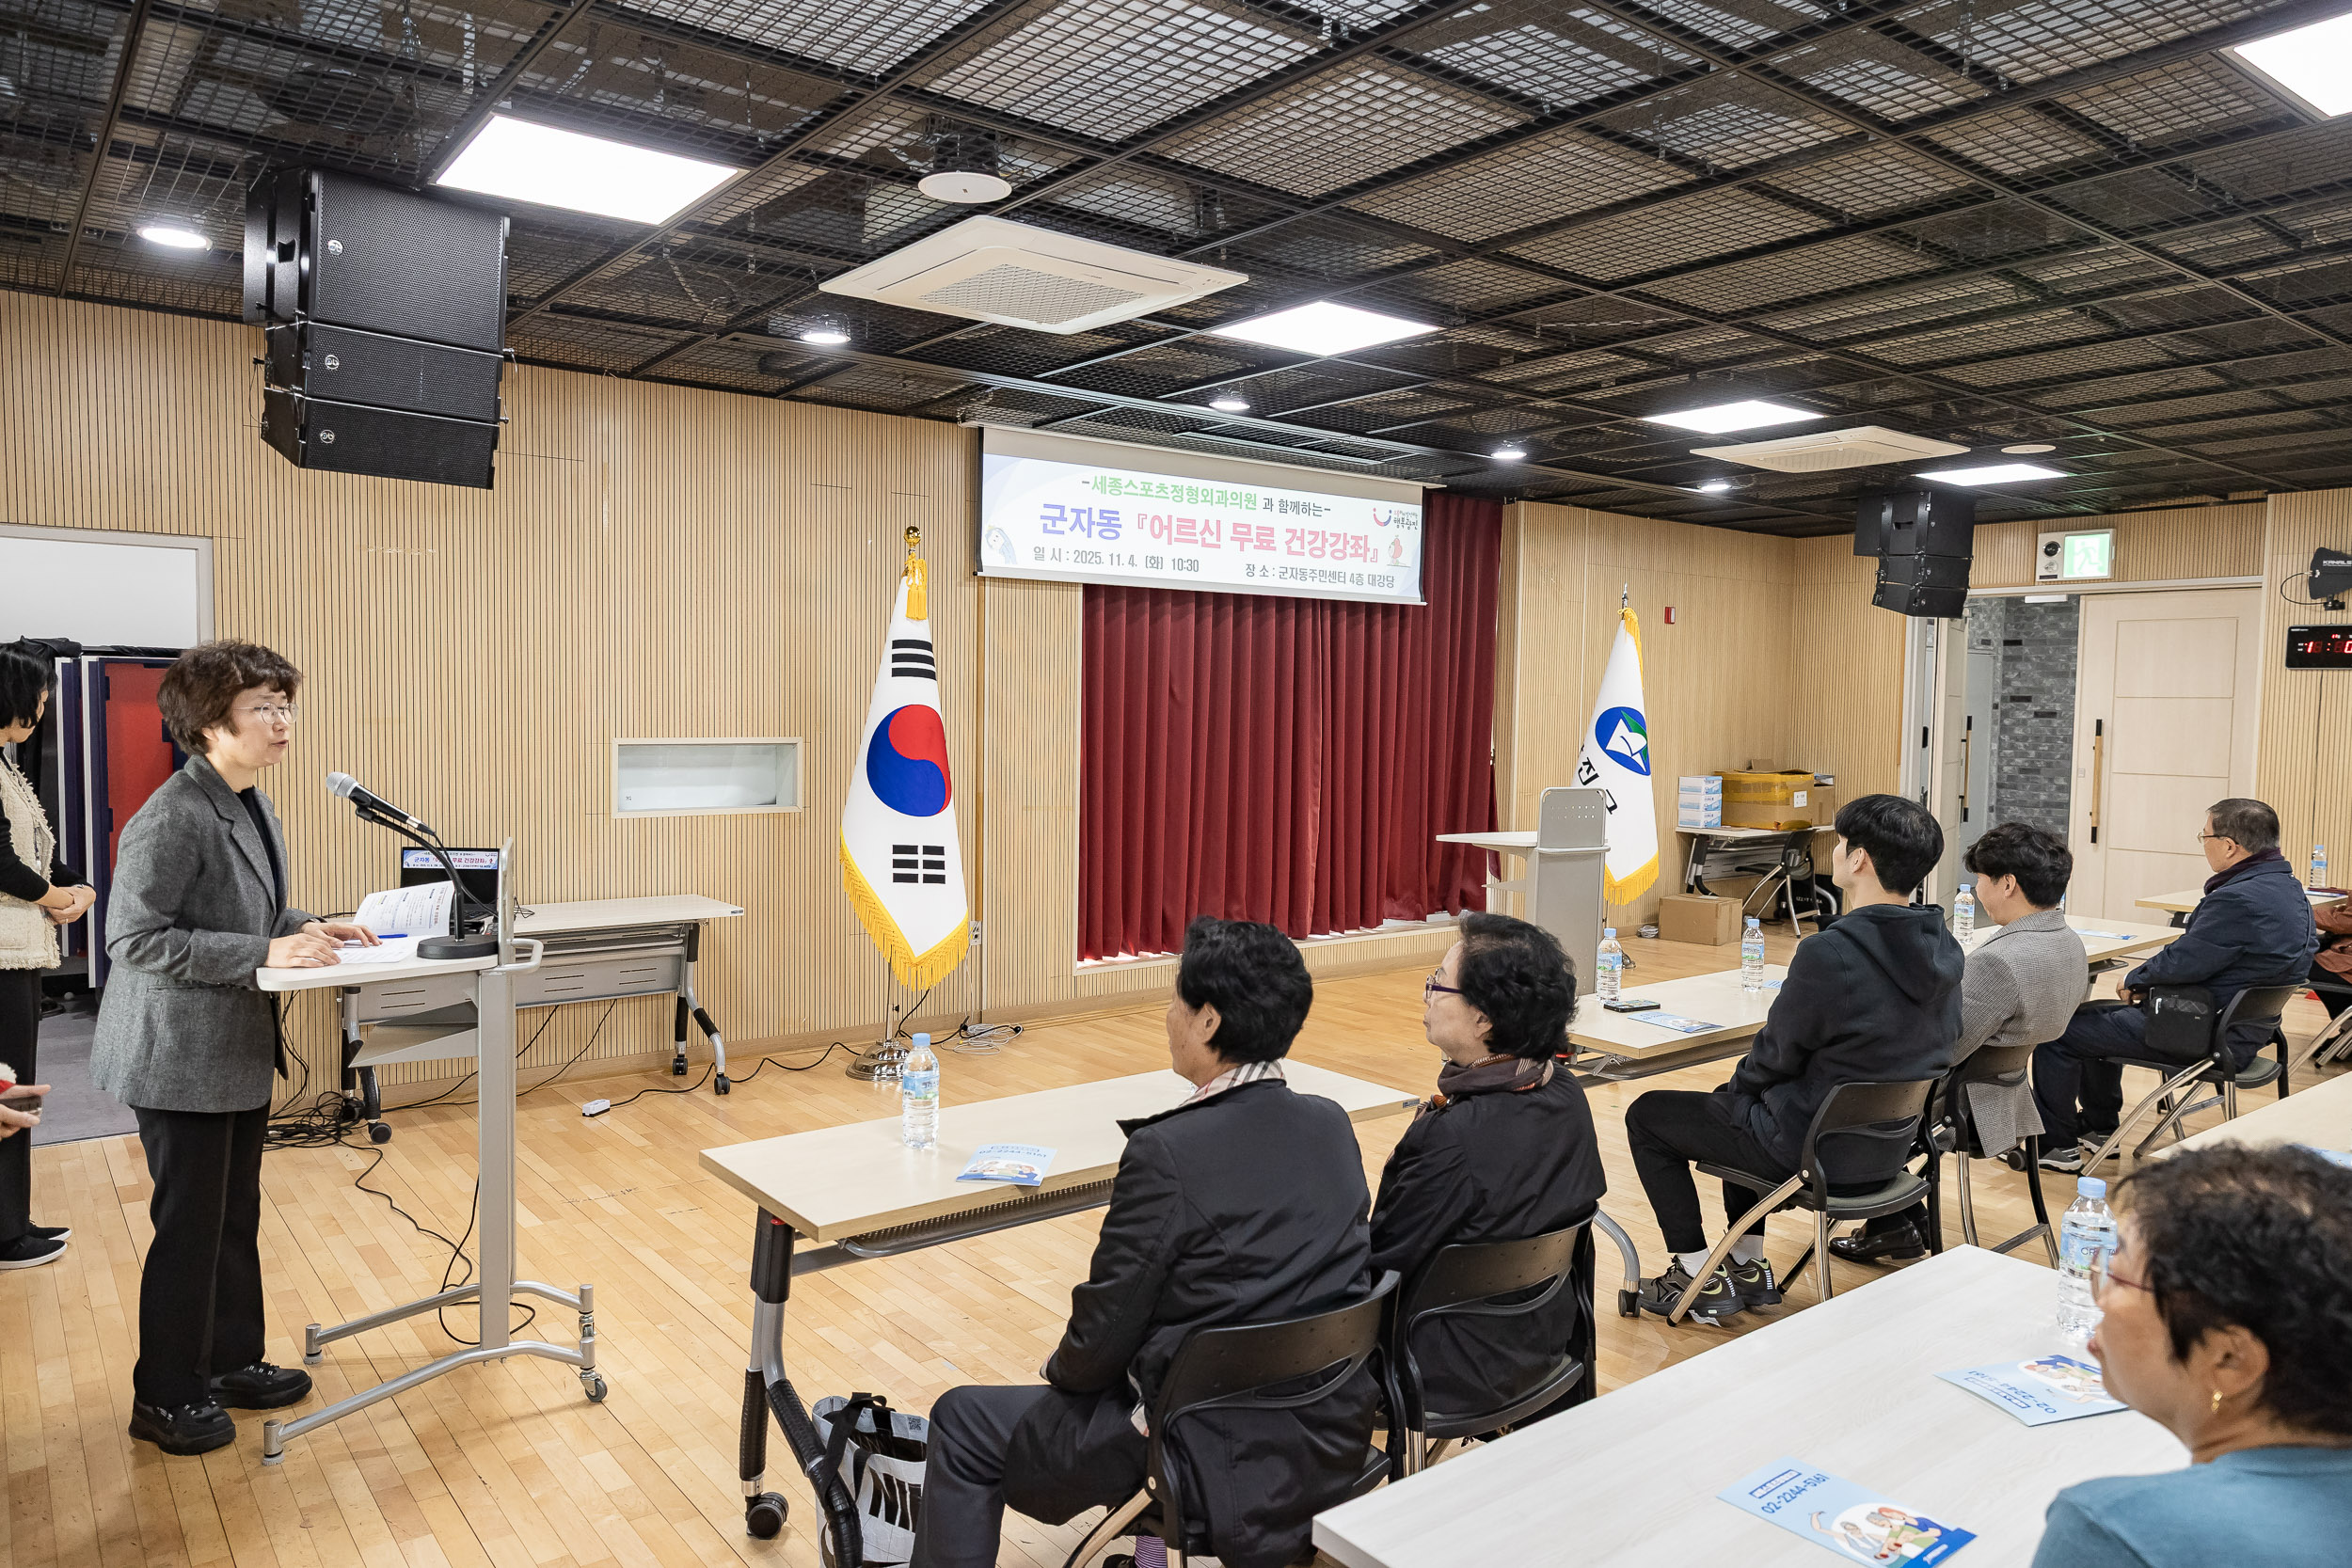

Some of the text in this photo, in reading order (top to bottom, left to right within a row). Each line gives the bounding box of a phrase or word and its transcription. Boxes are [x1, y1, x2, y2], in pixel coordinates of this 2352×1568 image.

[1263, 497, 1274, 513] 과
[1040, 503, 1122, 541] 군자동
[1230, 522, 1277, 552] 무료
[1284, 528, 1378, 563] 건강강좌』
[1033, 546, 1045, 562] 일
[1073, 549, 1104, 564] 2025.
[1108, 552, 1124, 566] 11.
[1128, 554, 1137, 567] 4.
[1171, 558, 1200, 572] 10:30
[1246, 563, 1255, 578] 장
[1279, 565, 1346, 585] 군자동주민센터
[1349, 572, 1364, 586] 4층
[1367, 573, 1395, 589] 대강당
[1761, 1473, 1831, 1514] 02-2244-5161
